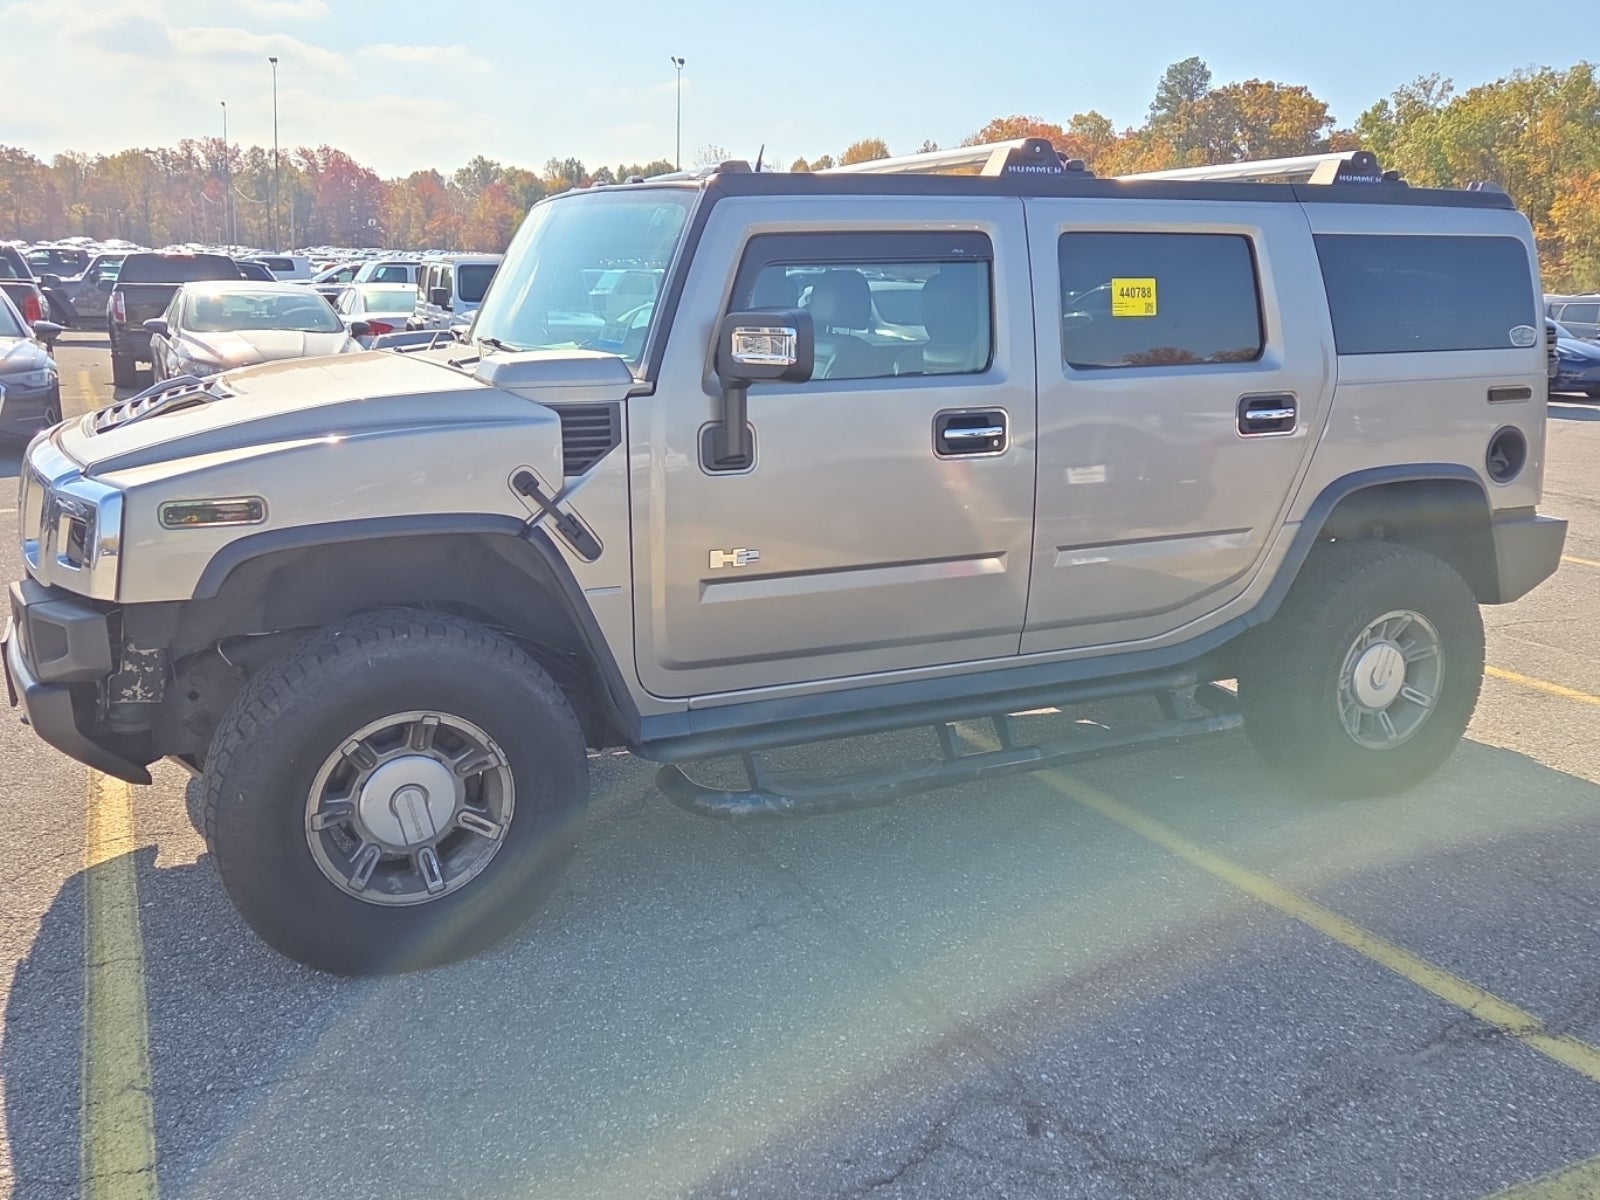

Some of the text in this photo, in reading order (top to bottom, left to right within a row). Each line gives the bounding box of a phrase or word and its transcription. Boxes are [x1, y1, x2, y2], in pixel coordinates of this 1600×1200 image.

[1008, 165, 1062, 174] HUMMER
[1339, 174, 1382, 183] HUMMER
[1119, 287, 1152, 299] 440788
[710, 549, 759, 568] H2
